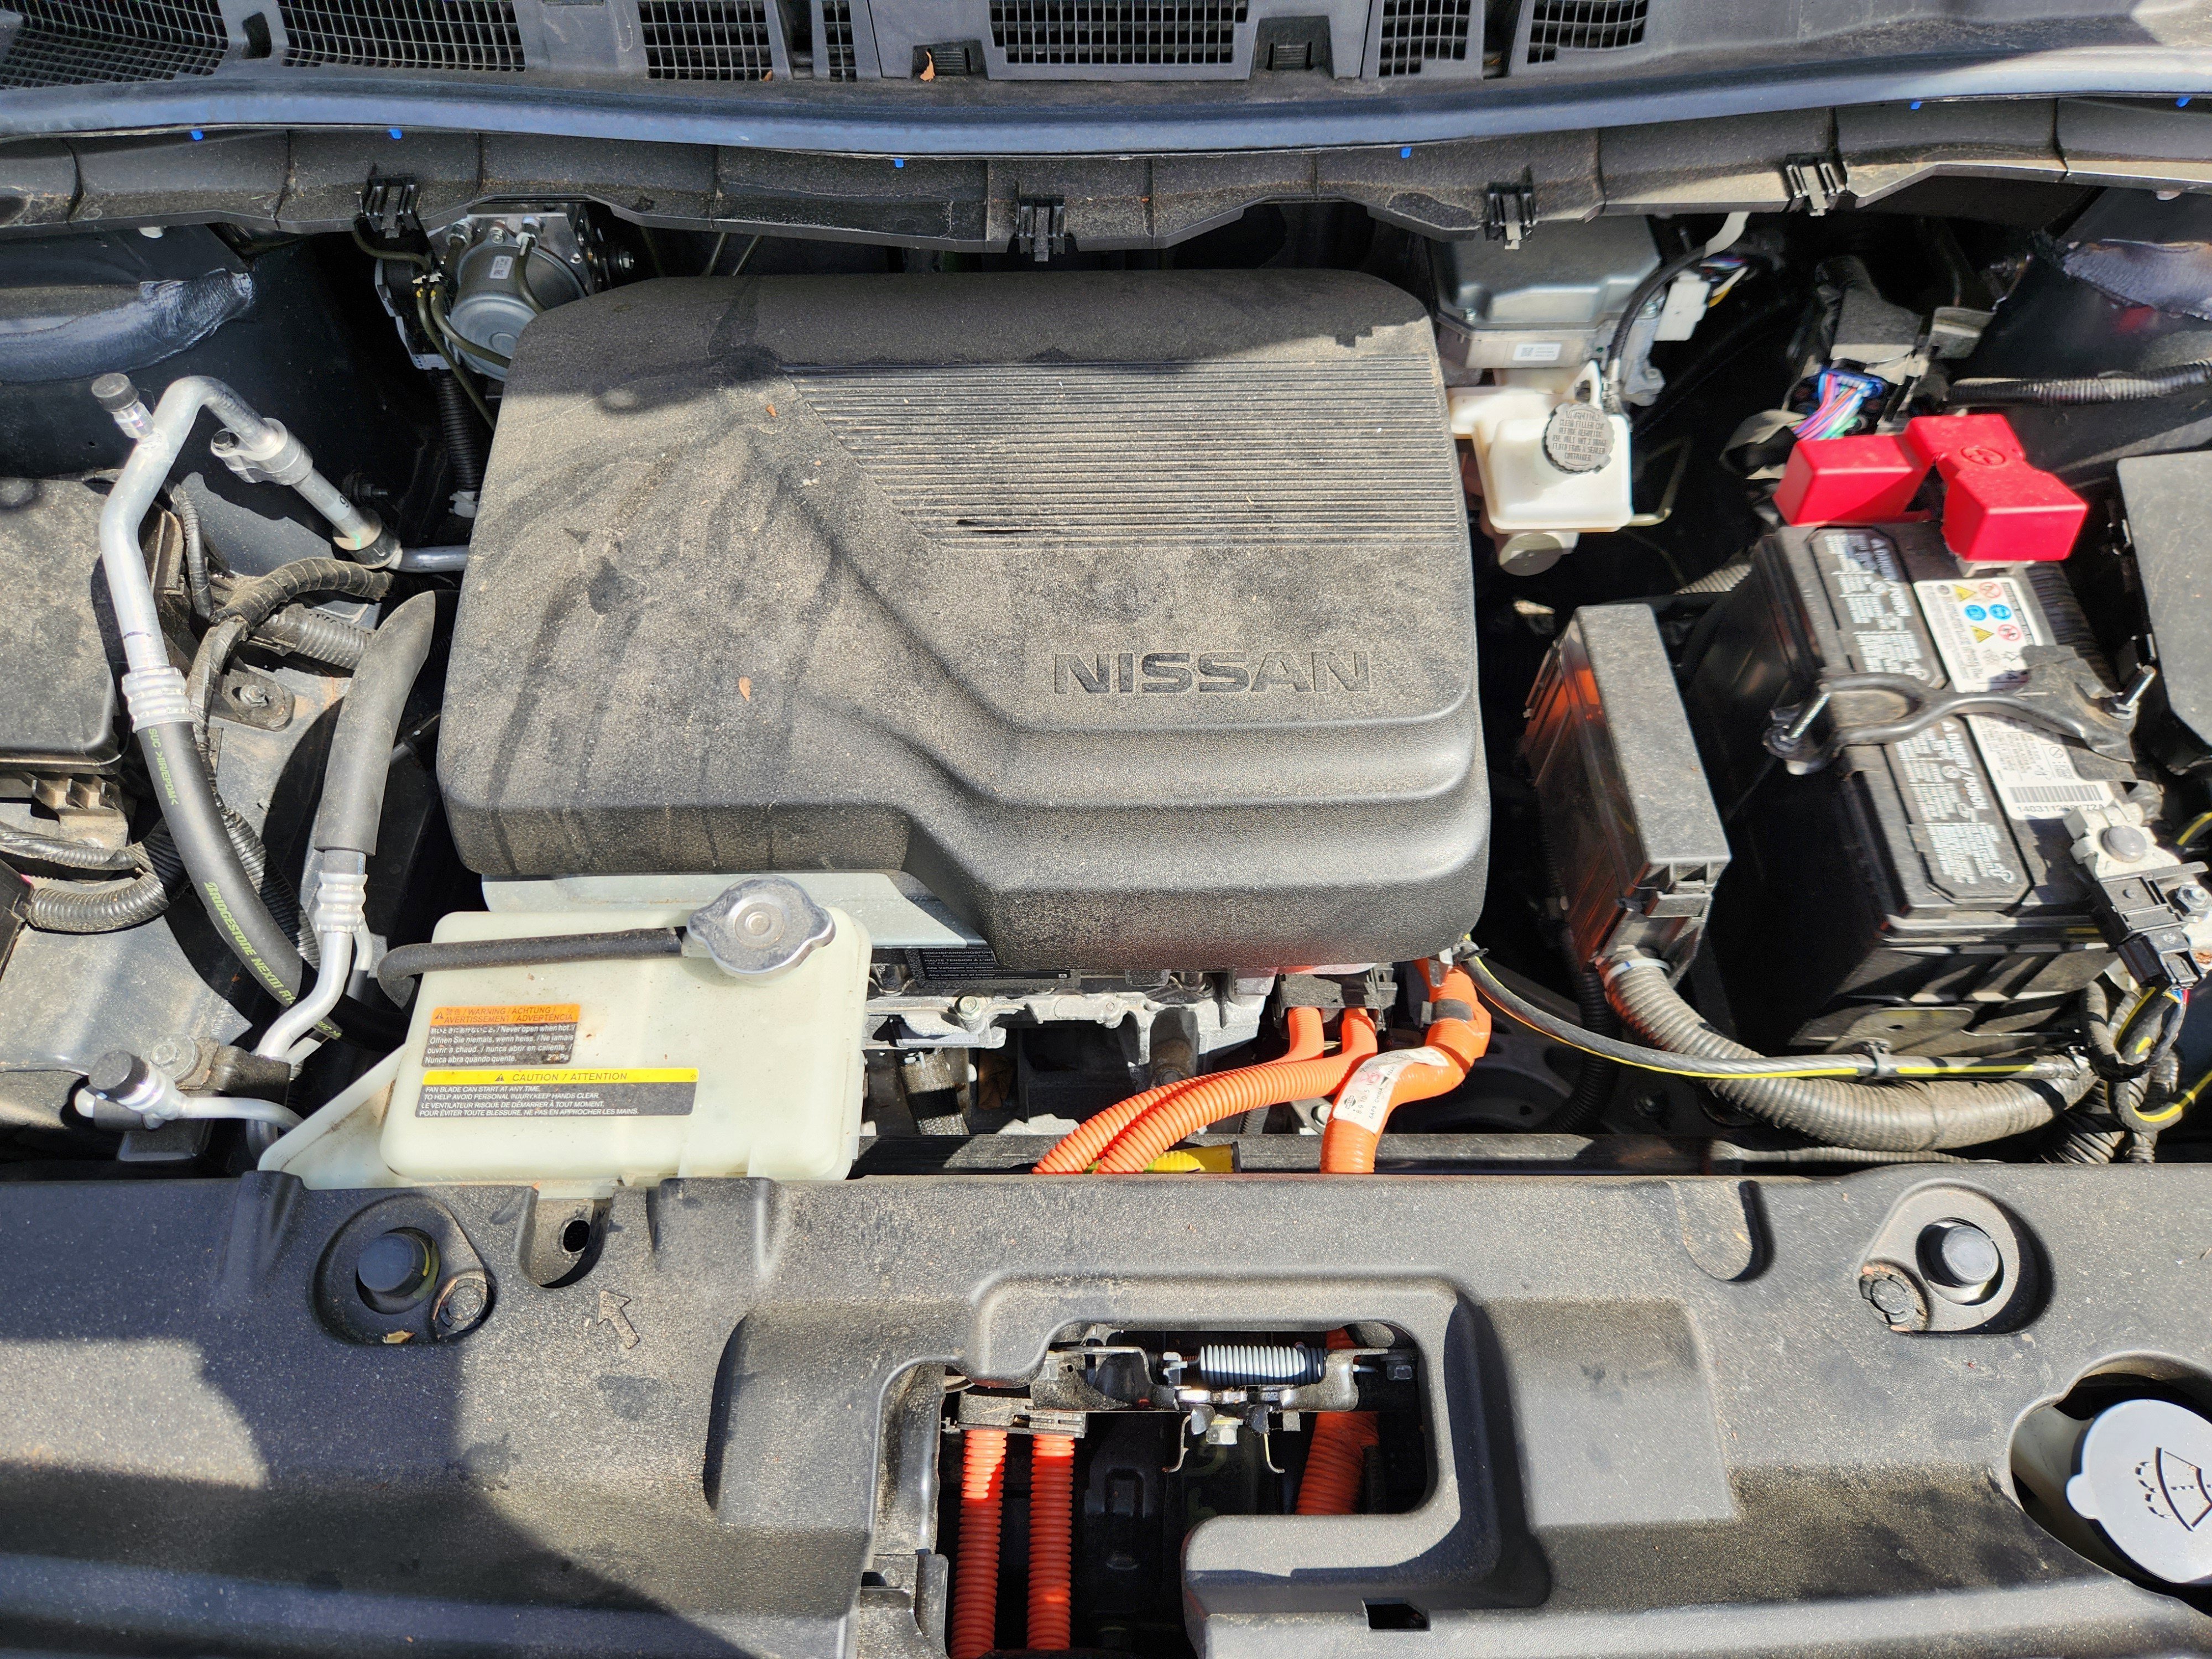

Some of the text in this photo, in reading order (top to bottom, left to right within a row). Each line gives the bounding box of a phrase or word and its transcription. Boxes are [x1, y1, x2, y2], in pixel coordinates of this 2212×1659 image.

[1054, 651, 1371, 695] NISSAN
[149, 728, 161, 748] SUC
[205, 882, 257, 956] BRIDGESTONE
[279, 990, 296, 1005] R1
[468, 1007, 505, 1016] WARNING
[512, 1006, 551, 1015] ACHTUNG
[444, 1015, 509, 1024] AVERTISSEMENT
[522, 1026, 539, 1034] open
[551, 1034, 574, 1043] jamais
[465, 1056, 491, 1064] quando
[491, 1055, 517, 1063] quente.
[512, 1073, 559, 1082] CAUTION
[570, 1072, 628, 1081] ATTENTION
[512, 1100, 549, 1108] DÉMARRER
[440, 1108, 462, 1117] ÉVITER
[560, 1108, 602, 1116] APPROCHER
